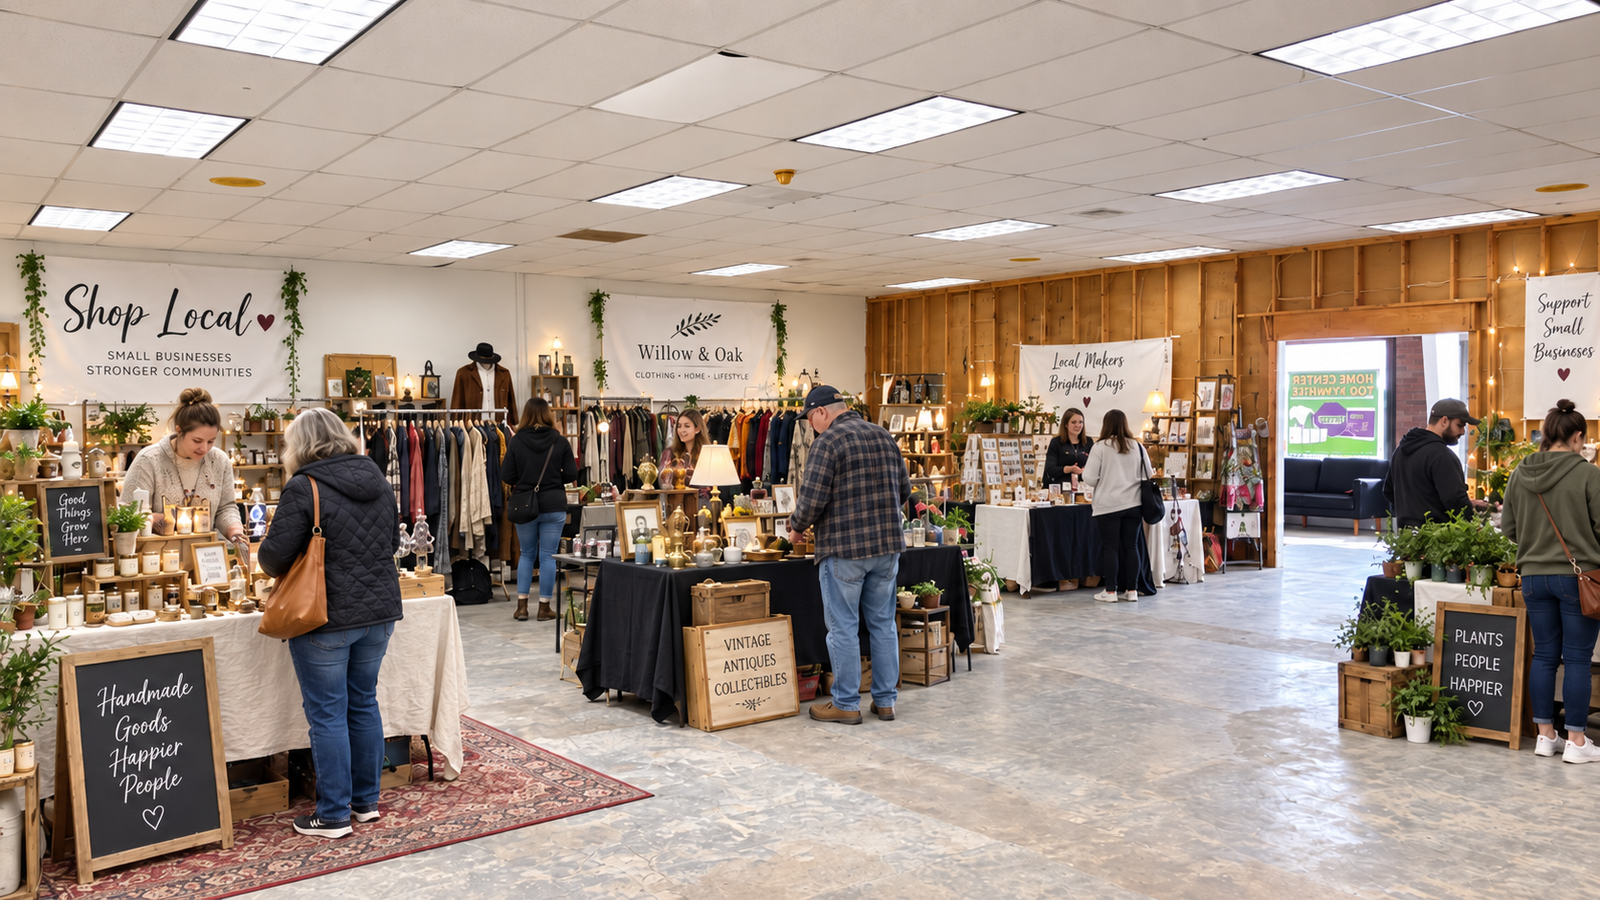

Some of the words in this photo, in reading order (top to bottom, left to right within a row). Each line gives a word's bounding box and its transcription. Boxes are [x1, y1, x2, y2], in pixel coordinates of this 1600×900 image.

[63, 283, 150, 344] Shop
[156, 287, 253, 338] Local
[1538, 292, 1593, 315] Support
[1543, 316, 1585, 338] Small
[107, 350, 151, 362] SMALL
[155, 351, 232, 363] BUSINESSES
[638, 344, 694, 361] Willow
[698, 346, 710, 362] &
[715, 347, 743, 362] Oak
[1052, 351, 1081, 370] Local
[1084, 350, 1124, 369] Makers
[86, 365, 158, 377] STRONGER
[163, 366, 253, 378] COMMUNITIES
[635, 371, 675, 380] CLOTHING
[684, 372, 706, 380] HOME
[713, 373, 749, 381] LIFESTYLE
[1049, 374, 1092, 396] Brighter
[1096, 373, 1125, 395] Days
[59, 491, 87, 507] Good
[56, 507, 93, 521] Things
[61, 521, 90, 533] Grow
[62, 532, 90, 546] Here
[723, 633, 772, 651] VINTAGE
[1455, 628, 1504, 647] PLANTS
[723, 653, 777, 673] ANTIQUES
[1454, 653, 1501, 672] PEOPLE
[714, 672, 788, 696] COLLECTIBLES
[1450, 676, 1503, 697] HAPPIER
[97, 672, 193, 717] Handmade
[115, 708, 172, 742] Goods
[109, 741, 183, 778] Happier
[119, 766, 183, 804] People
